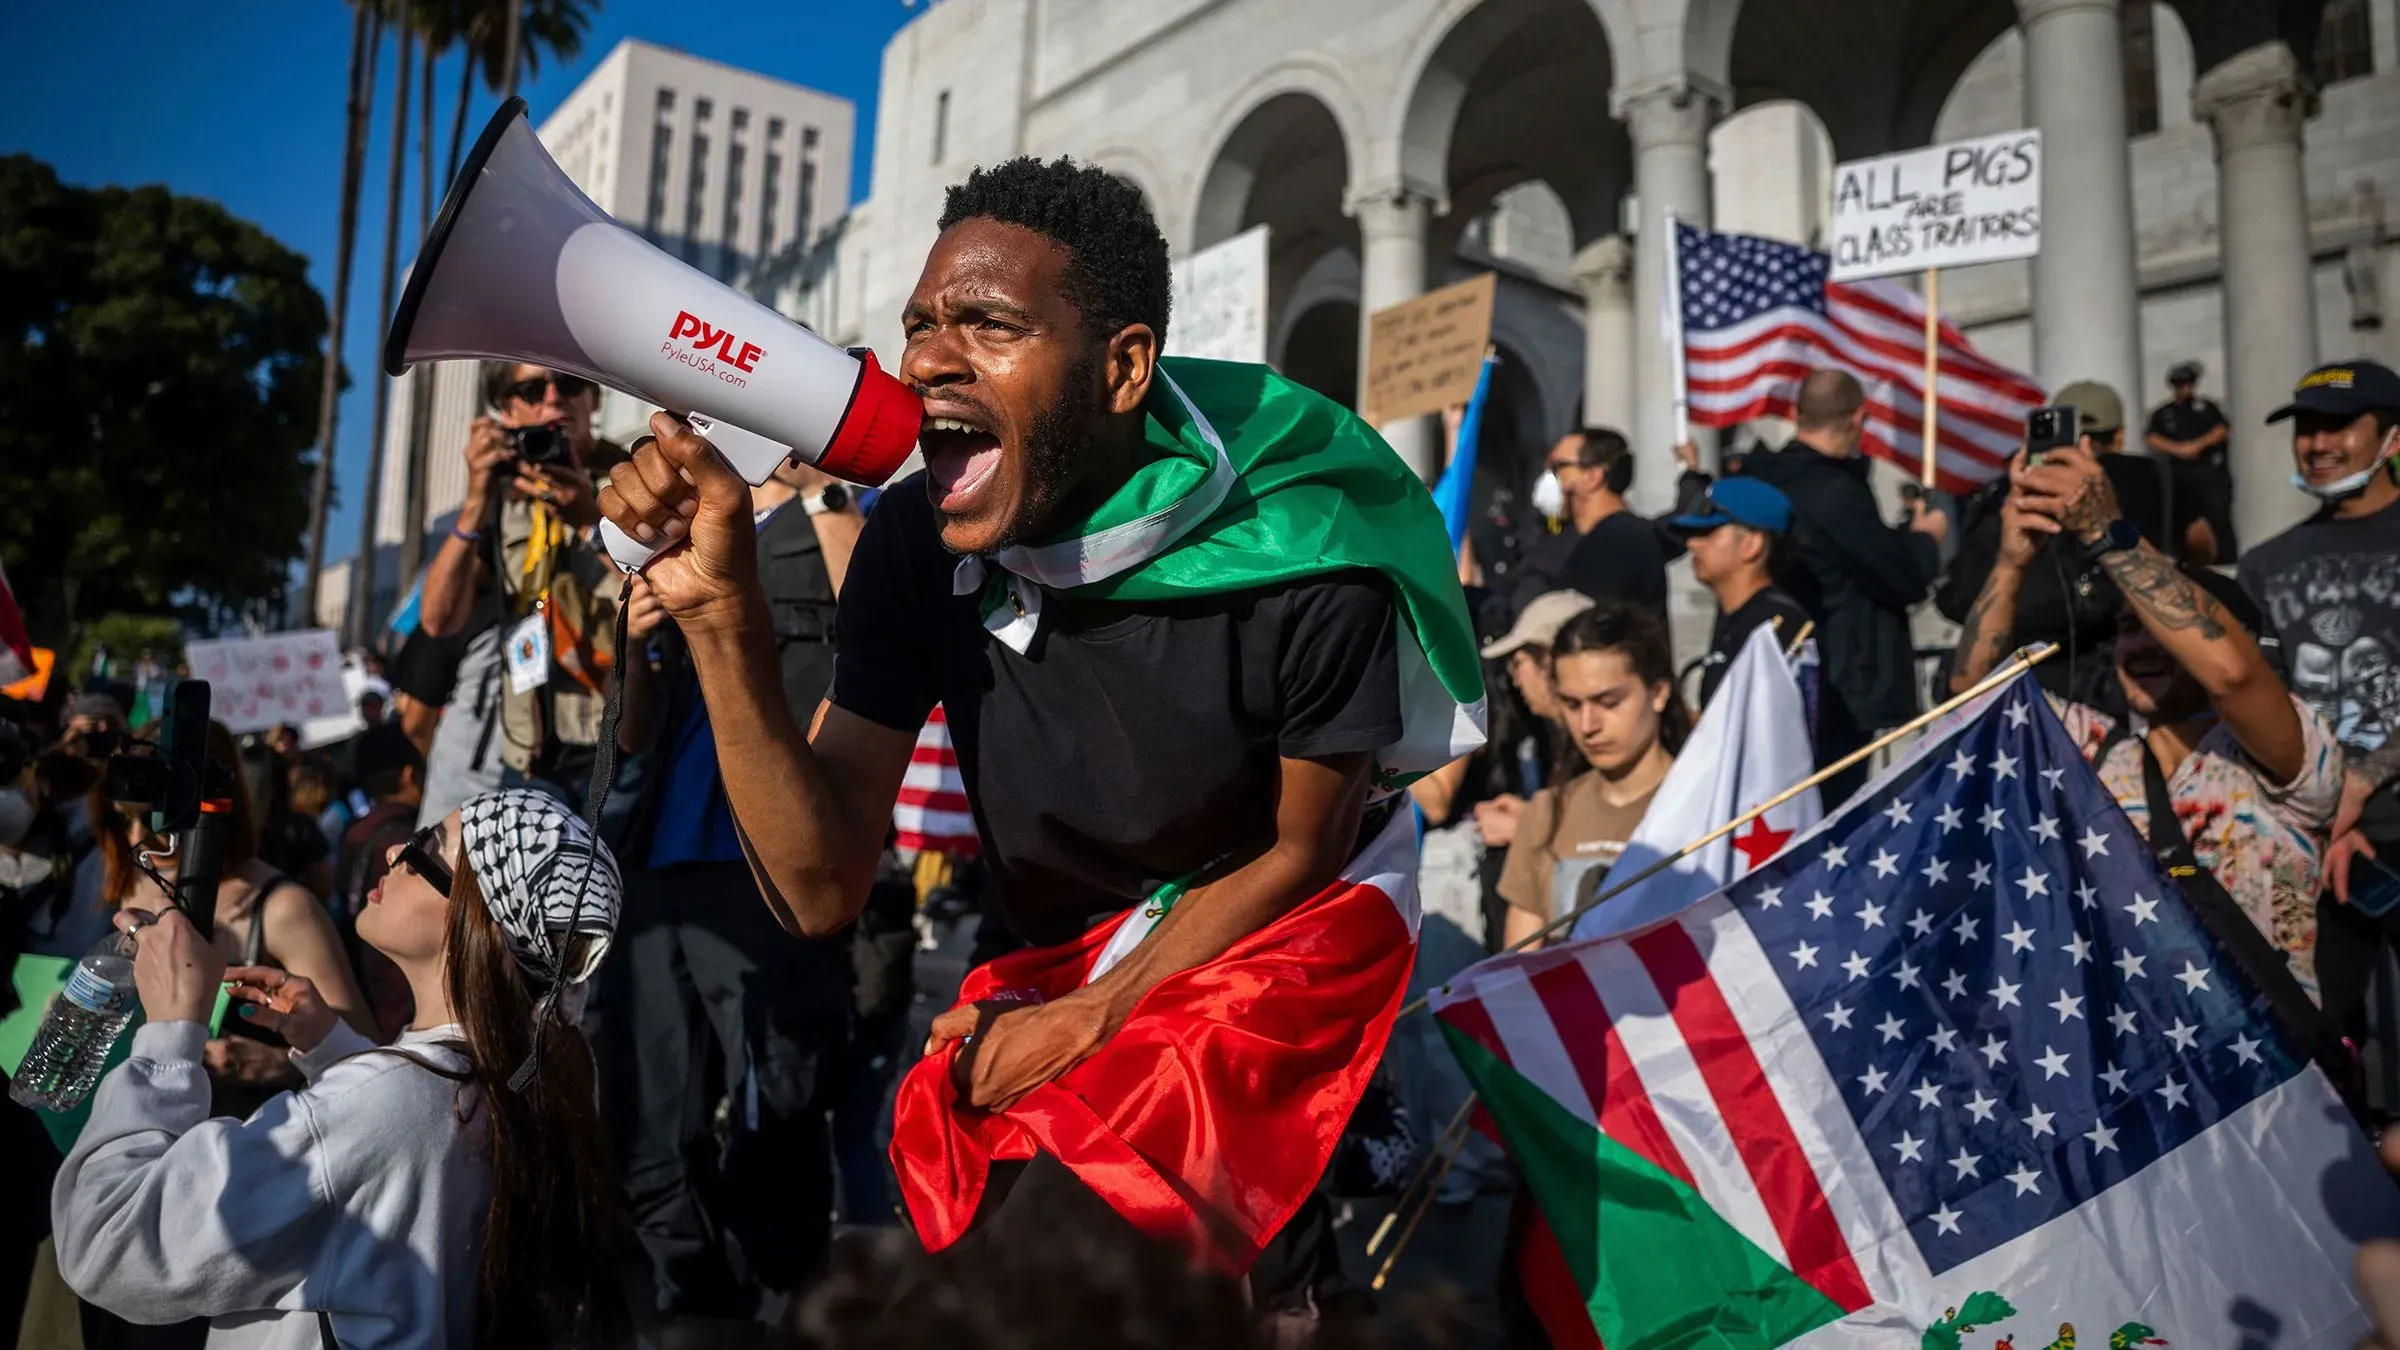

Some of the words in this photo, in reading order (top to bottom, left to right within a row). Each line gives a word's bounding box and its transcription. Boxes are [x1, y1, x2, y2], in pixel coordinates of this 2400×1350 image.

[1838, 164, 1920, 215] ALL
[1943, 136, 2039, 188] PIGS
[1904, 190, 1964, 219] ARE
[1836, 222, 1915, 268] CLASS
[661, 341, 747, 389] PyleUSA.com
[669, 310, 763, 373] PYLE
